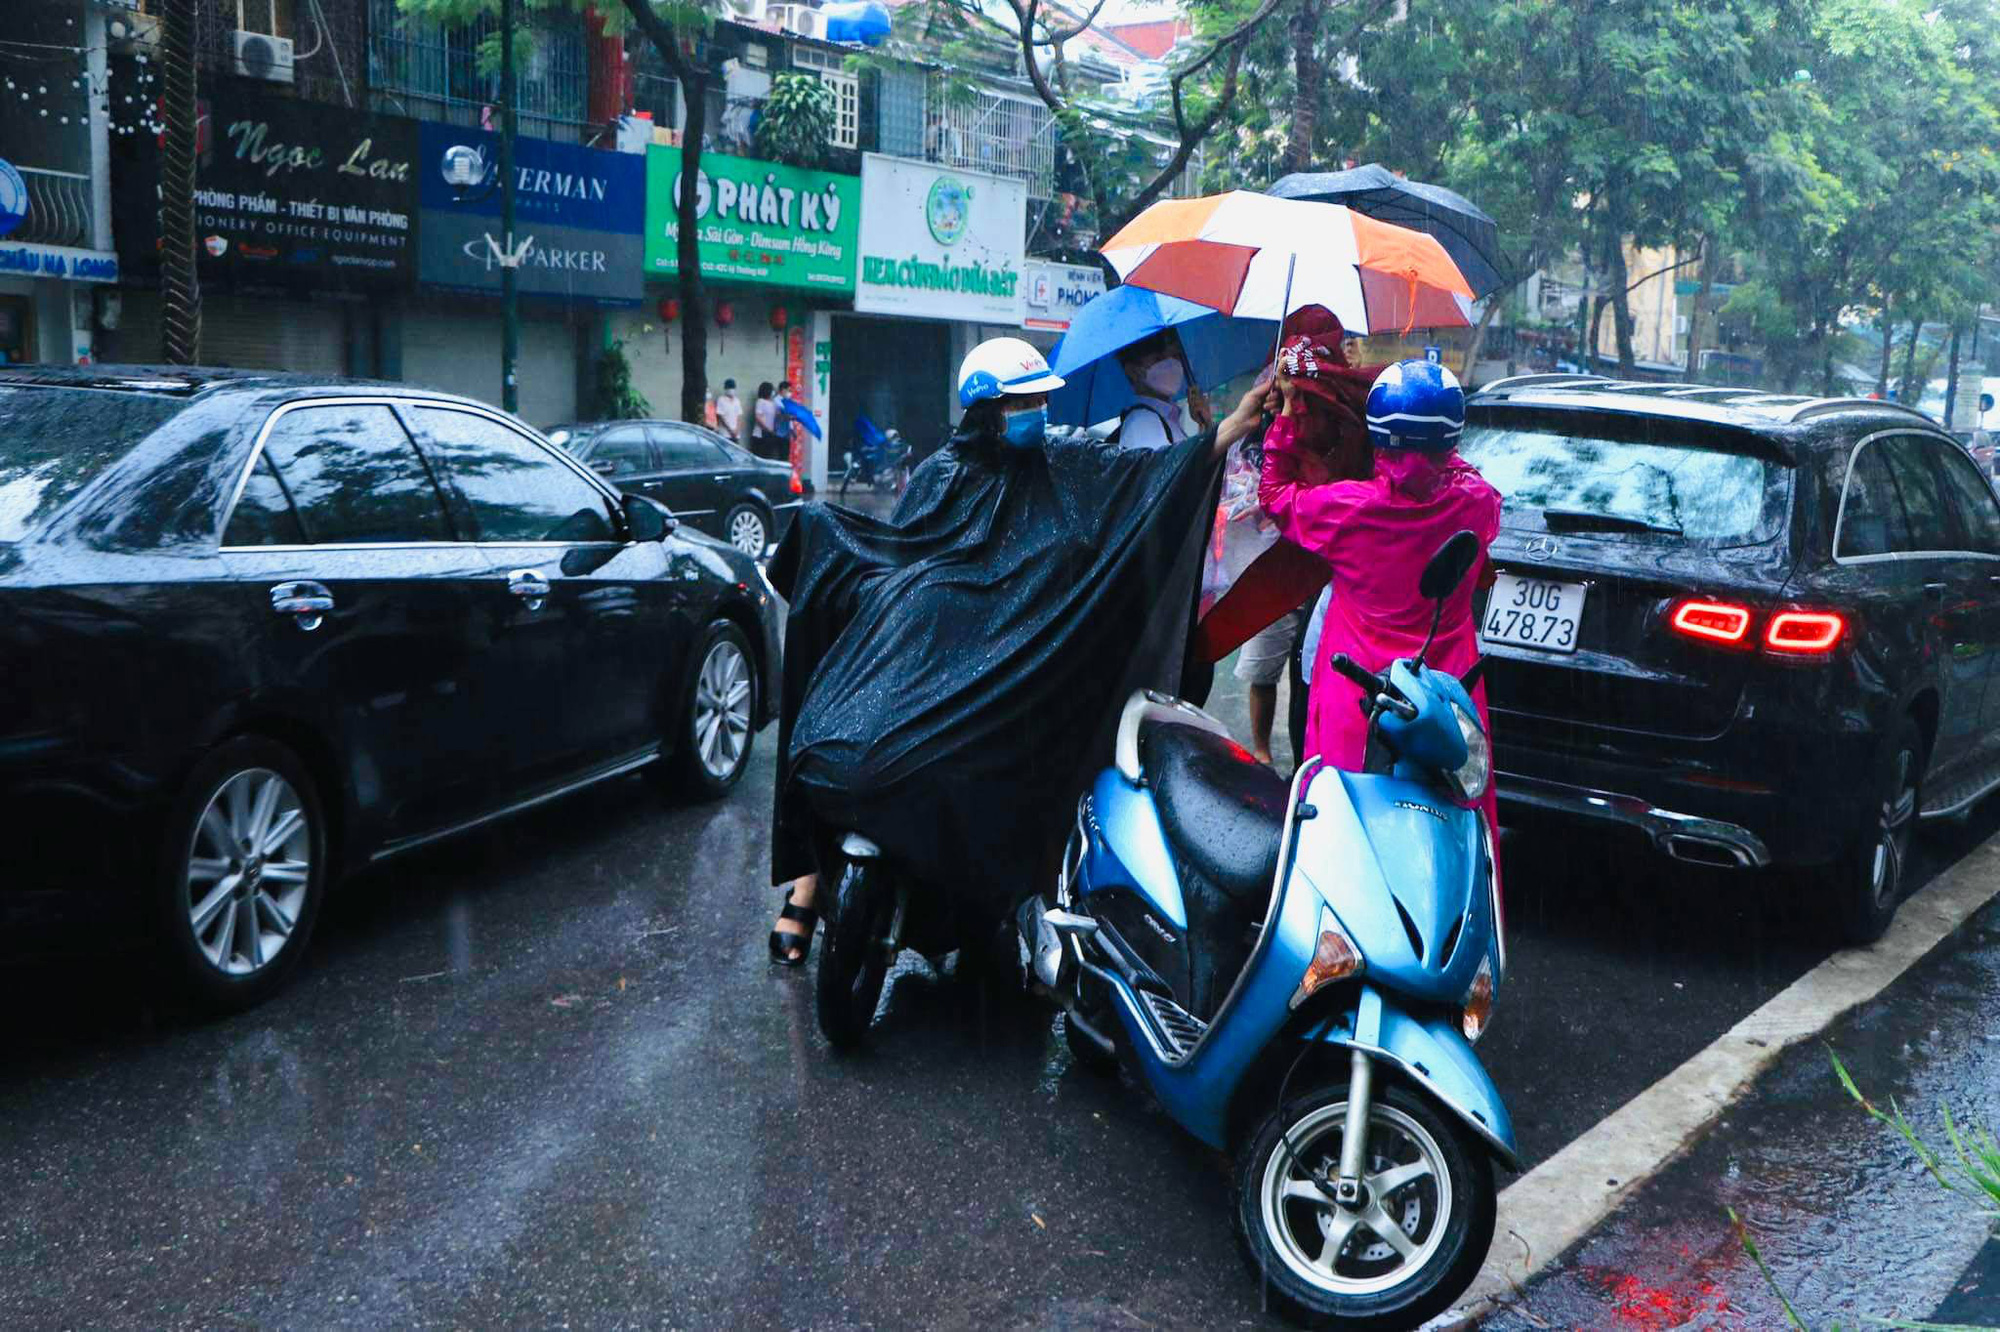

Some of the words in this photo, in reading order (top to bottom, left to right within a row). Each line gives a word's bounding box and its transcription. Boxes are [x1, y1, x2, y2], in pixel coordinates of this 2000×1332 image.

[227, 120, 324, 177] Ngọc
[337, 137, 410, 183] Lan
[716, 172, 795, 228] PHÁT
[368, 207, 409, 231] PHÒNG
[520, 245, 607, 273] PARKER
[1511, 580, 1563, 612] 30G
[1486, 608, 1576, 647] 478.73
